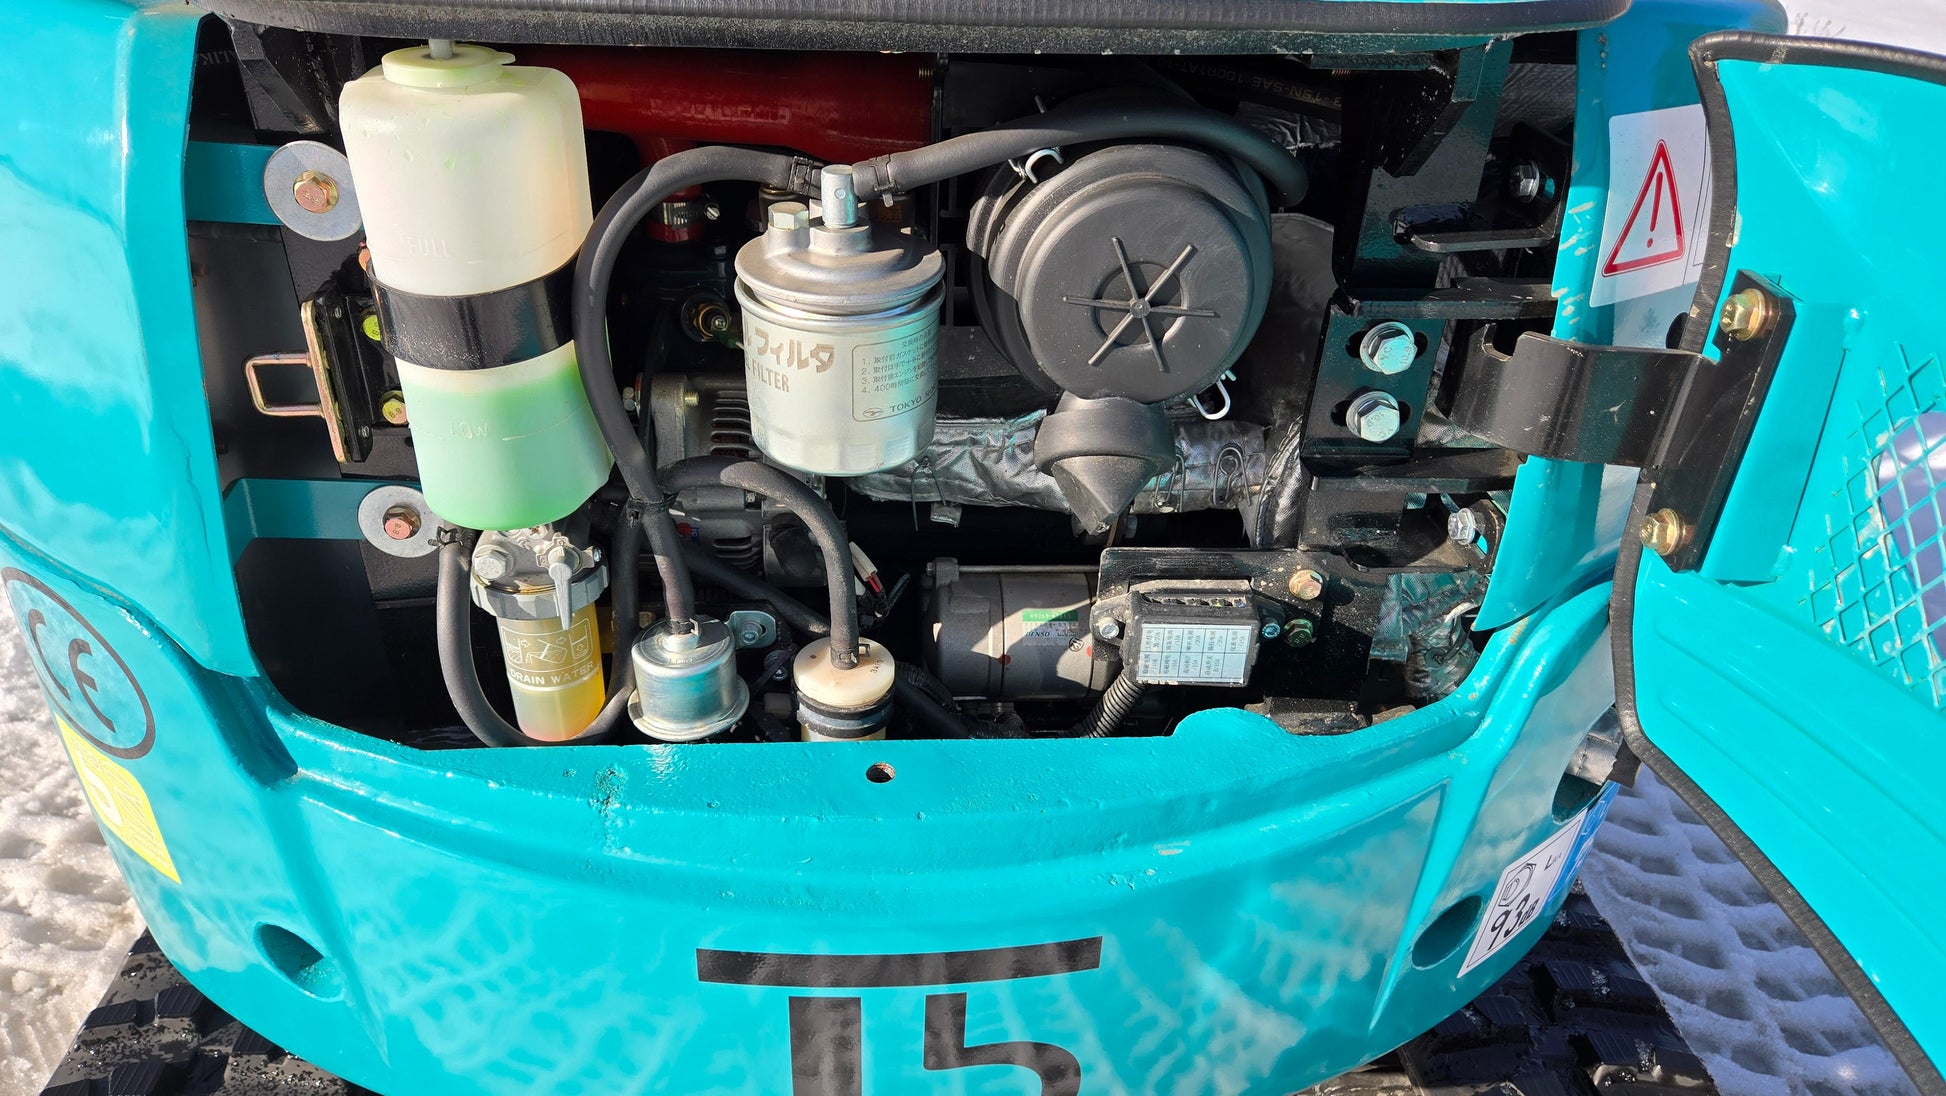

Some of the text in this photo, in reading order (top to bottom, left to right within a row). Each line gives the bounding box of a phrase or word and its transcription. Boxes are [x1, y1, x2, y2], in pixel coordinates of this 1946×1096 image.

[408, 236, 449, 257] FULL
[752, 358, 789, 392] FILTER
[889, 396, 922, 413] TOKYO
[449, 420, 489, 441] LOW
[27, 608, 117, 734] CE
[509, 661, 594, 685] DRAIN WATER
